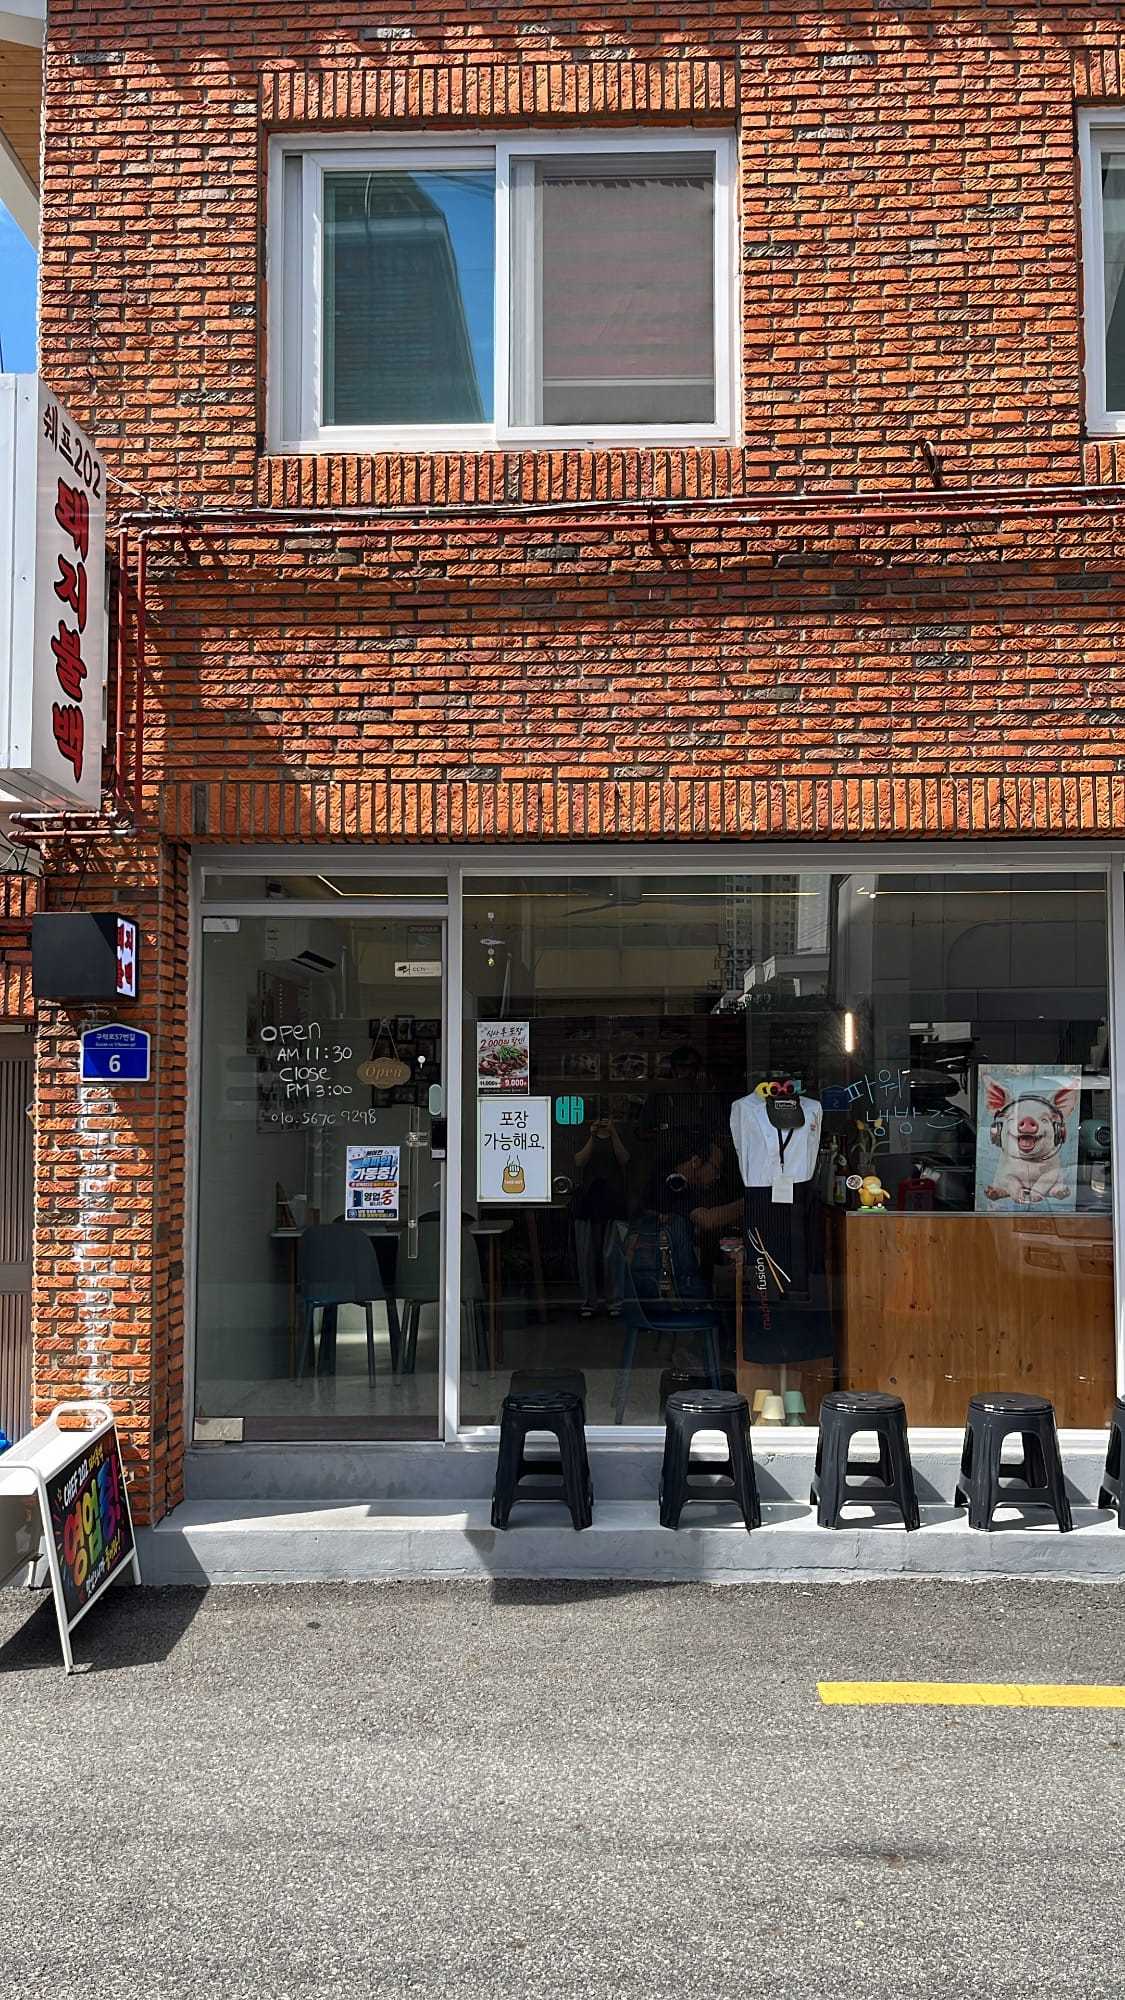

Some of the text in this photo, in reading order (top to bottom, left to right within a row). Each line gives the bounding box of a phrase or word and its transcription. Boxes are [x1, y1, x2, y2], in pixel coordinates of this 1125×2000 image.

[43, 403, 101, 499] 쉐프202
[51, 477, 90, 783] 돼지불백
[510, 1026, 524, 1036] 포장
[109, 1054, 121, 1073] 6
[276, 1046, 353, 1063] AM 11:30
[366, 1065, 402, 1080] Open
[286, 1083, 353, 1099] PM 3:00
[843, 1068, 903, 1104] 파워
[499, 1111, 528, 1129] 포장
[484, 1133, 545, 1151] 가능해요.
[354, 1166, 398, 1181] 가동중!
[64, 1471, 78, 1507] CHEF
[78, 1459, 89, 1486] 202
[64, 1454, 121, 1586] 영업중!
